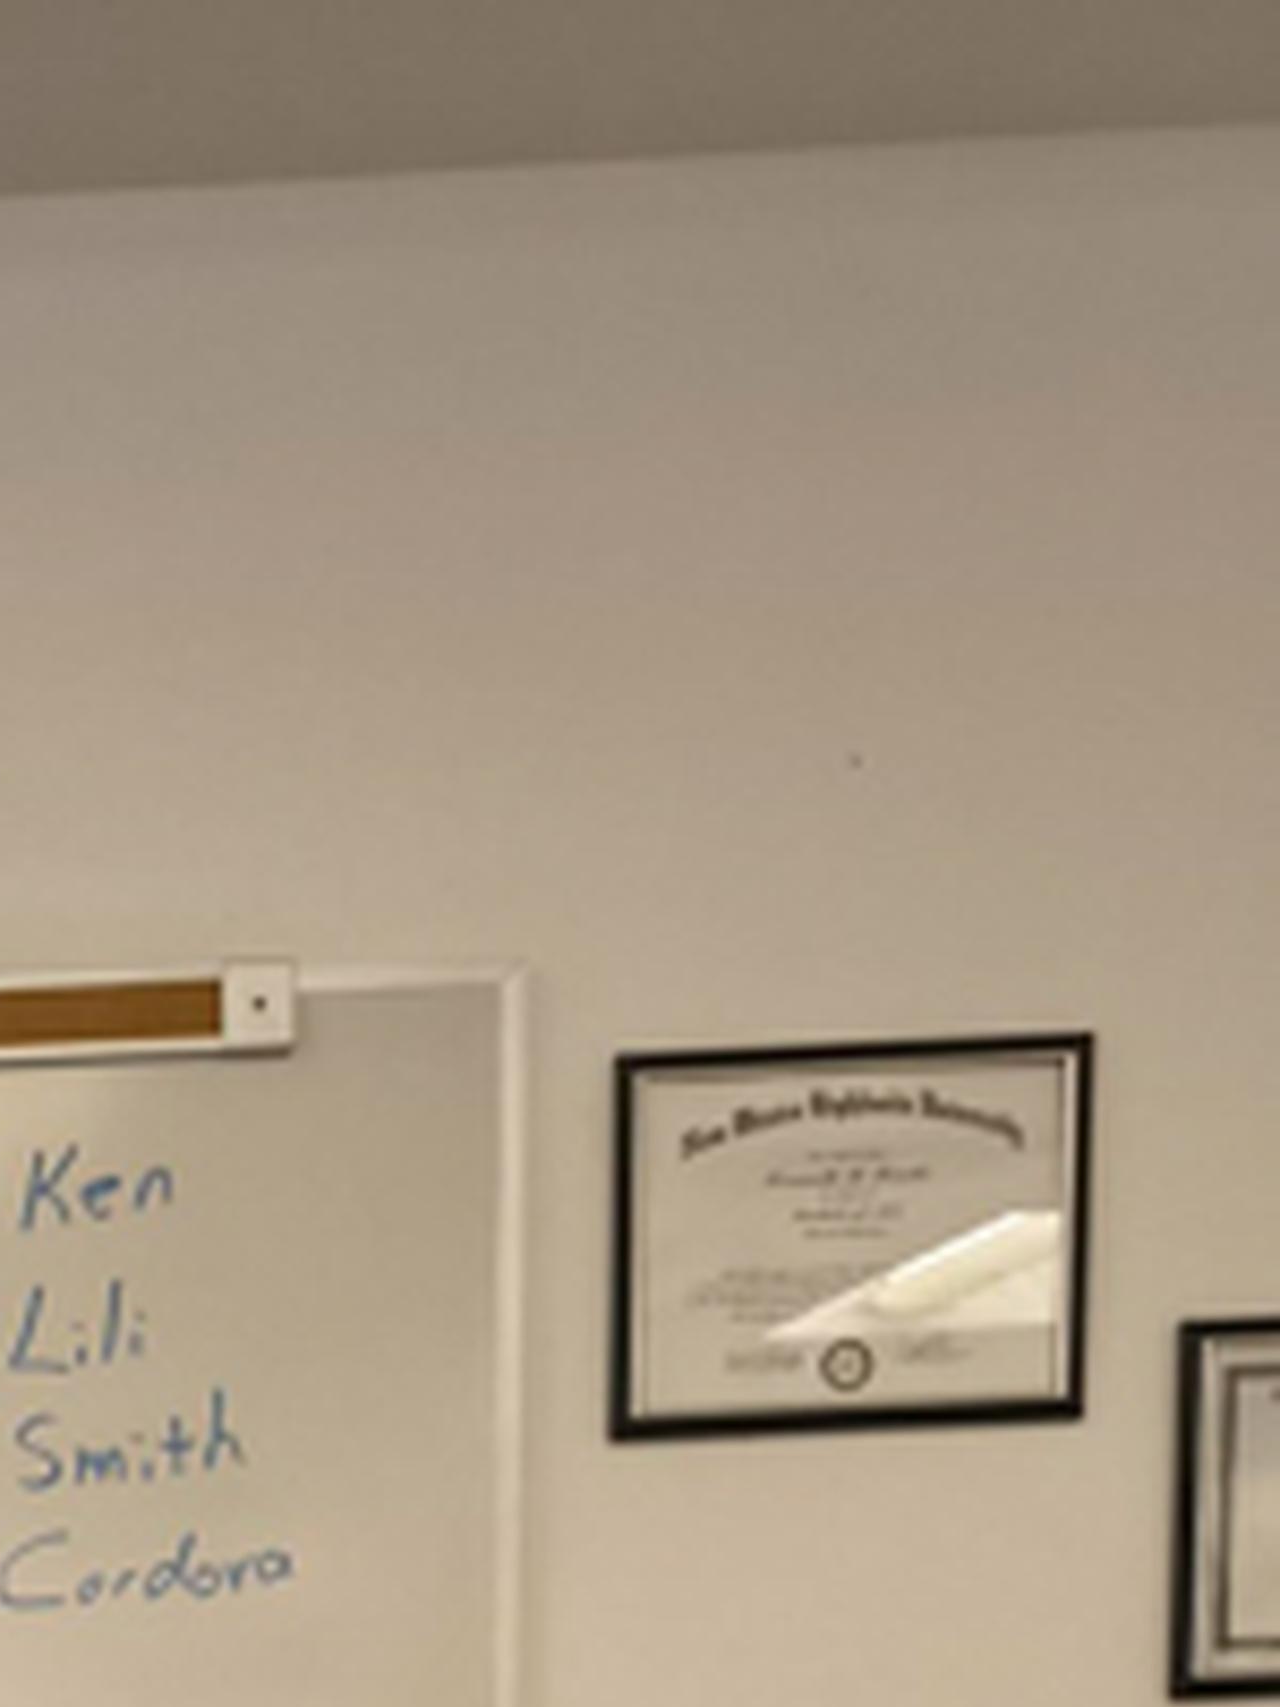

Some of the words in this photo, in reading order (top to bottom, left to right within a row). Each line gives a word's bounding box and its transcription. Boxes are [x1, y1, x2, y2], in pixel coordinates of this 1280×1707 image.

[20, 1144, 174, 1230] Ken
[8, 1278, 146, 1375] Lili
[15, 1387, 248, 1491] Smith
